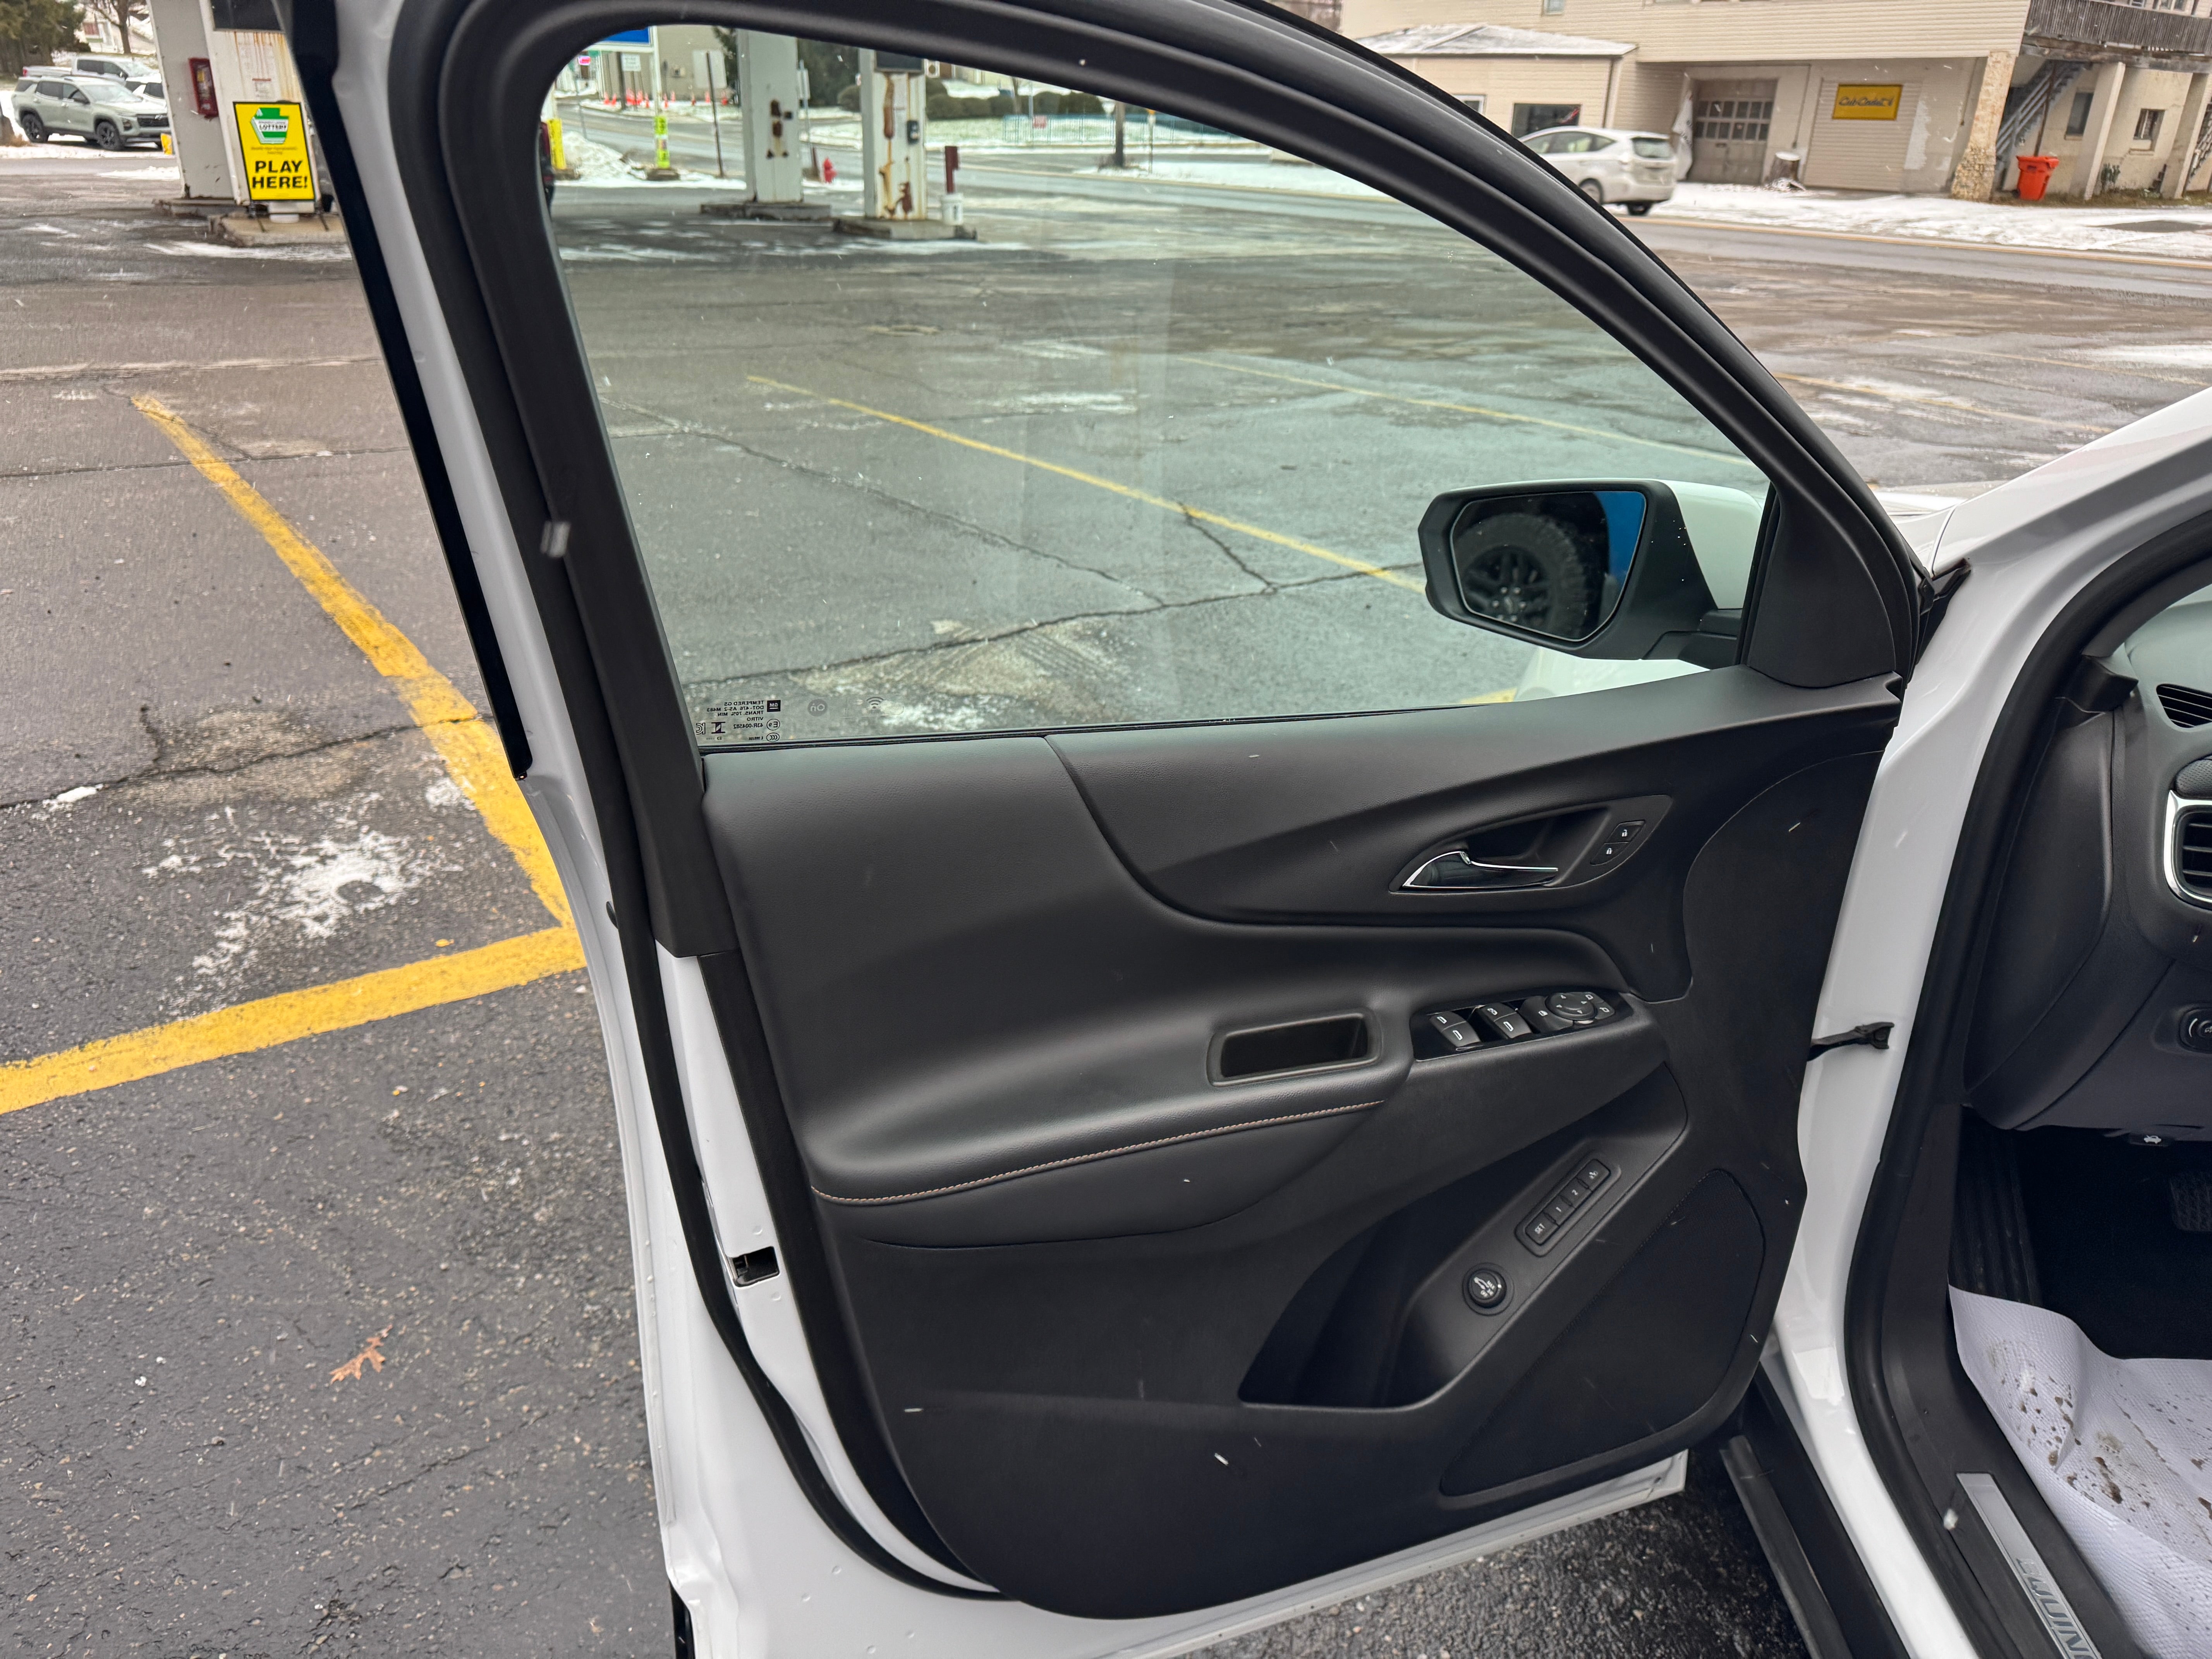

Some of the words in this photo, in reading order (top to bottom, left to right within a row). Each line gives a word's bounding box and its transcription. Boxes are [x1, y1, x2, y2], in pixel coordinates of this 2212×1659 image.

[255, 160, 303, 173] PLAY
[252, 176, 307, 189] HERE!
[1535, 1223, 1545, 1234] SET
[2016, 1558, 2095, 1659] EQUIN
